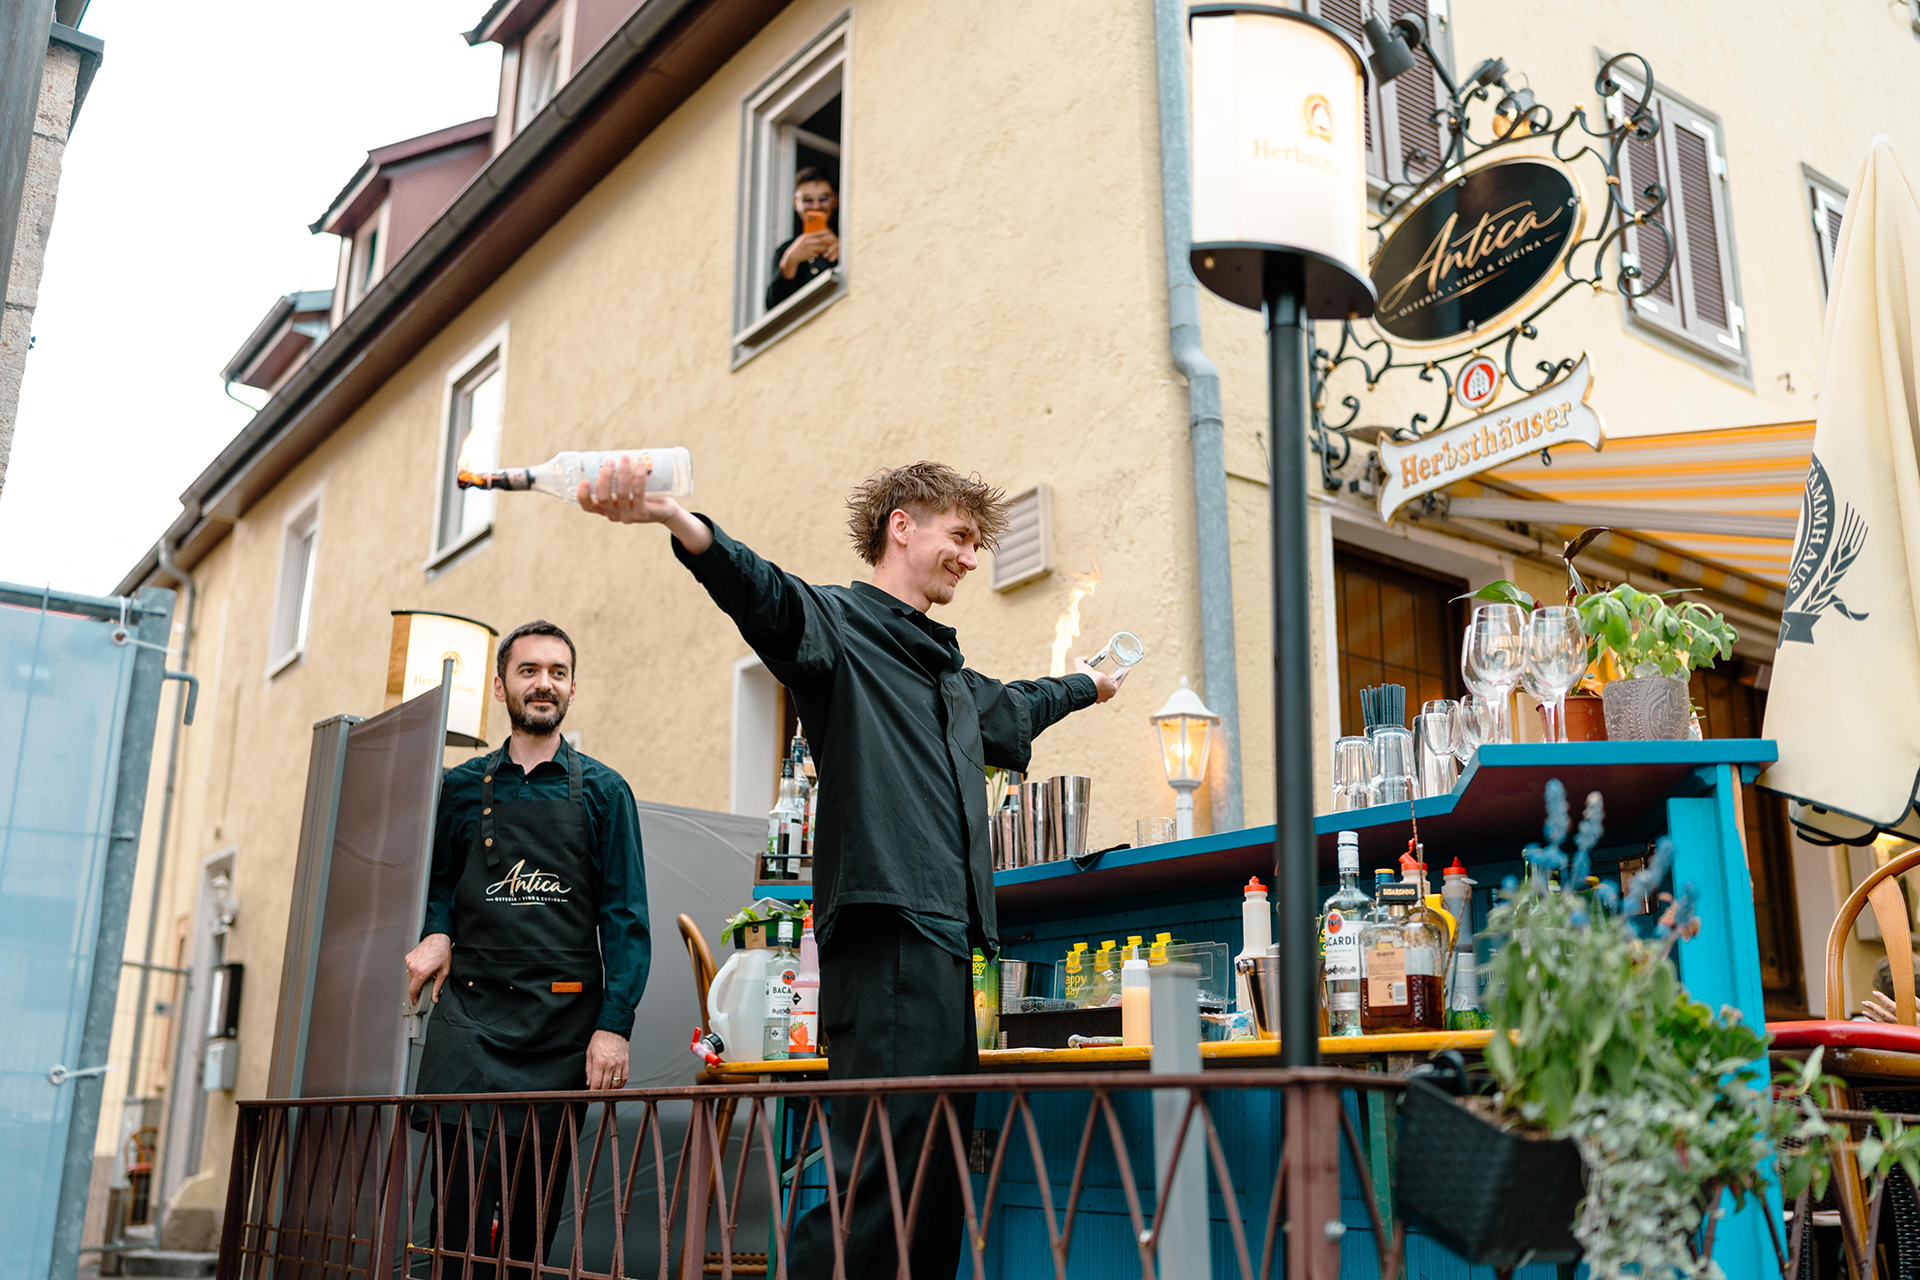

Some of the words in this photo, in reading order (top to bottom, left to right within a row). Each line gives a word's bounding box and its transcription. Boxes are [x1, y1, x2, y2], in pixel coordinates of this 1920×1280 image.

[1380, 200, 1563, 313] Antica
[1399, 289, 1444, 317] OSTERIA
[1455, 269, 1485, 288] VINO
[1497, 240, 1542, 267] CUCINA
[1400, 401, 1571, 489] Herbsthäuser
[1789, 461, 1829, 594] TAMMHAUS
[486, 859, 572, 897] Antica
[1326, 933, 1356, 946] CARDÍ
[1065, 975, 1087, 987] appy
